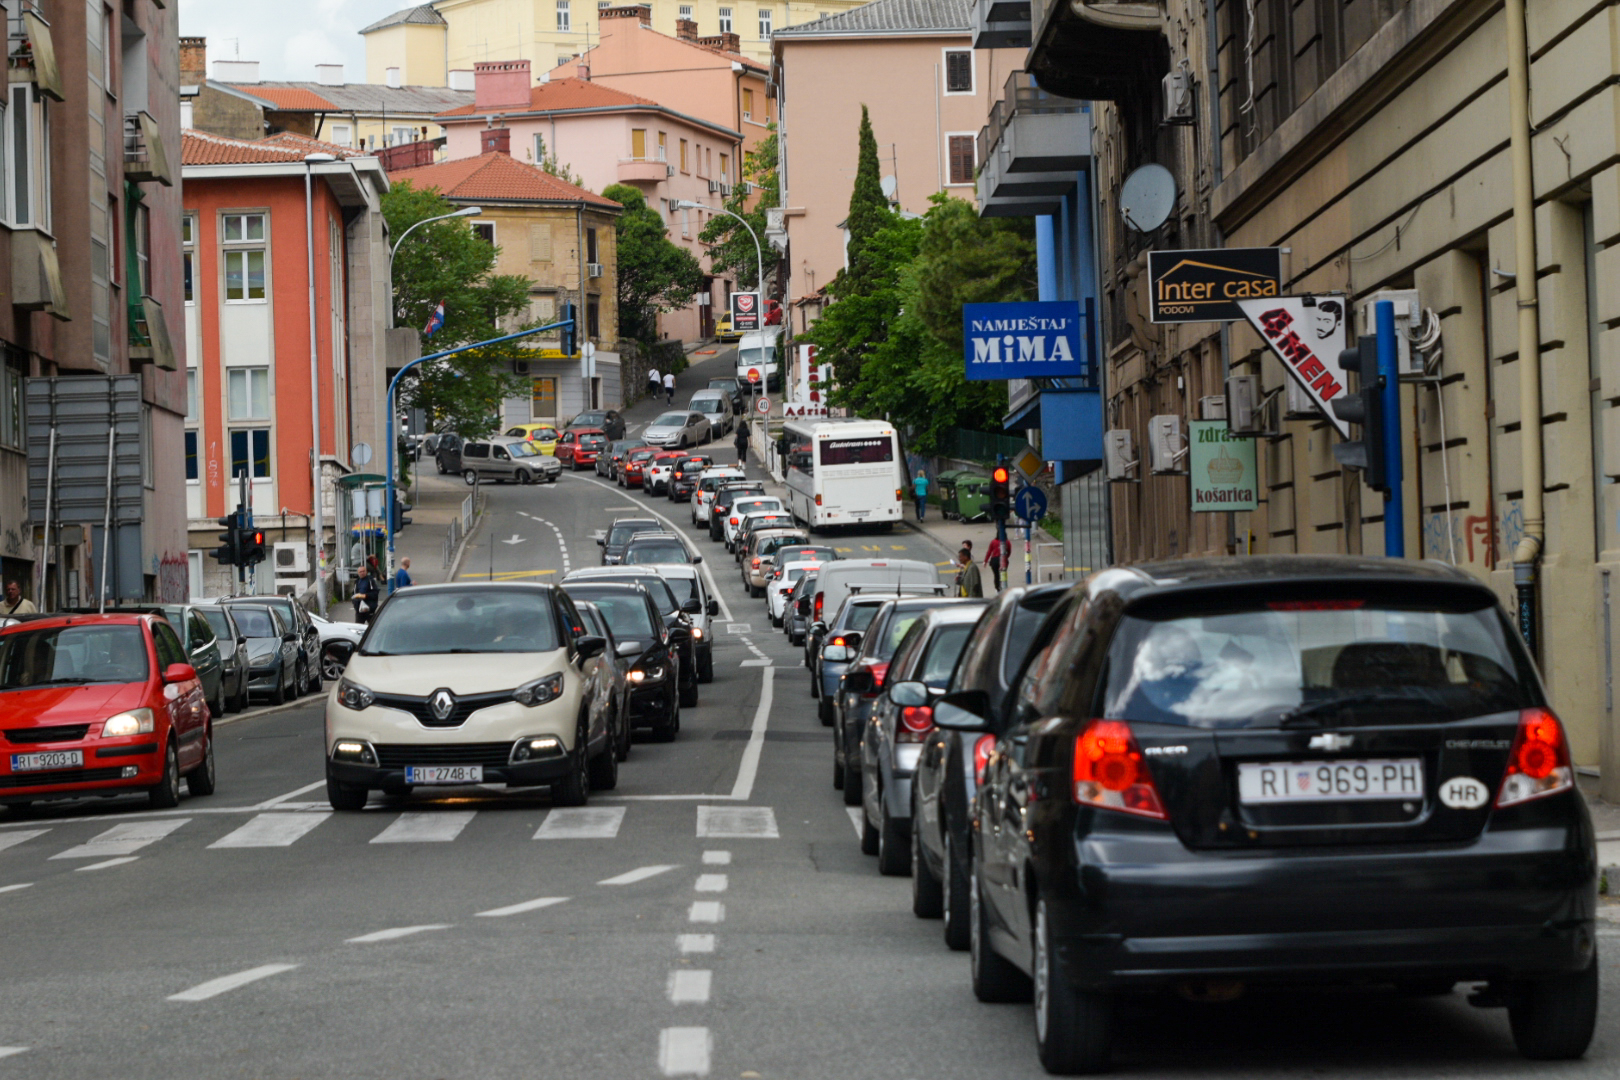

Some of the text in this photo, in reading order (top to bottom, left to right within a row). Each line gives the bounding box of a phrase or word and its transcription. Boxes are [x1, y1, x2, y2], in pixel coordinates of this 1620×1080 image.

[1158, 279, 1277, 301] Inter casa
[1158, 305, 1195, 315] PODOVI
[971, 316, 1067, 332] NAMJEŠTAJ
[971, 335, 1074, 363] MiMA
[760, 401, 768, 410] 40
[785, 403, 827, 416] Adria
[1195, 487, 1253, 504] košarica
[19, 752, 79, 767] RI 9203-D
[413, 767, 478, 781] RI 2748-C
[1261, 764, 1417, 796] RI 969-PH
[1450, 785, 1479, 801] HR
